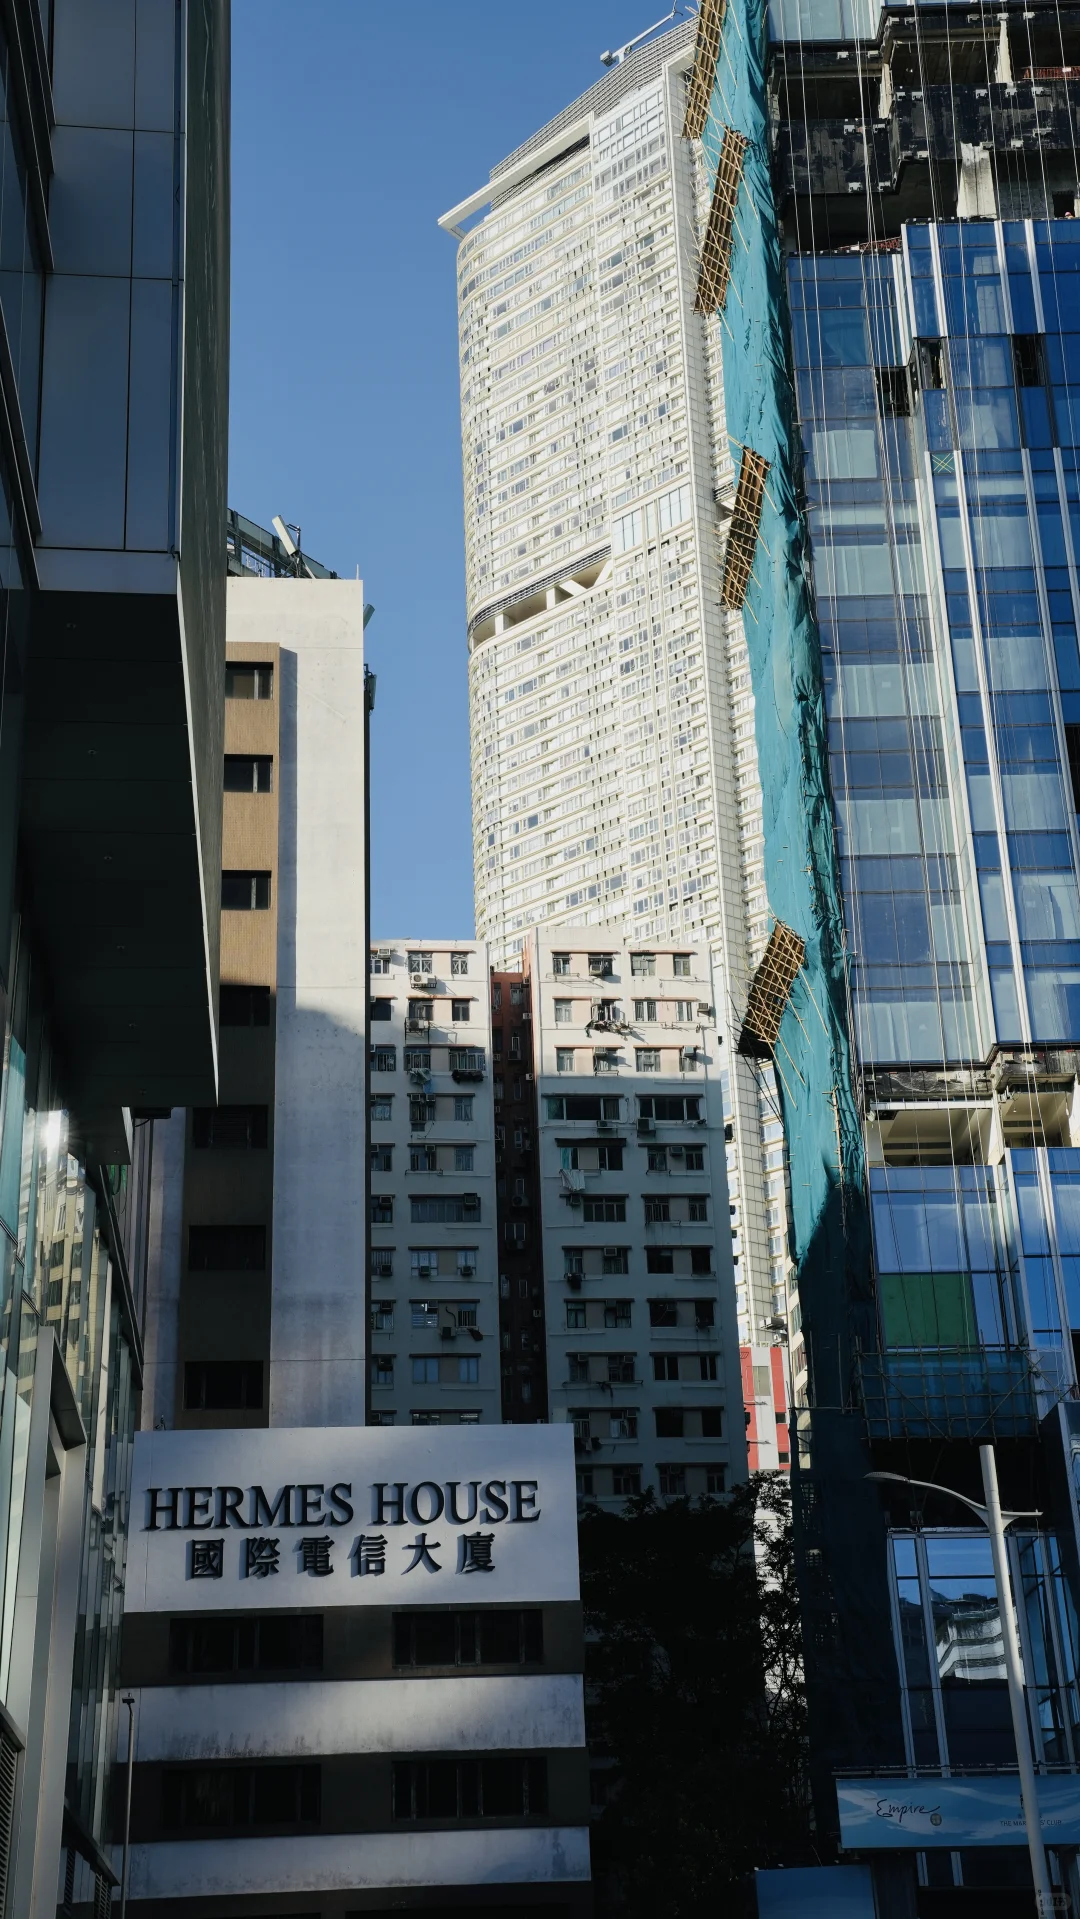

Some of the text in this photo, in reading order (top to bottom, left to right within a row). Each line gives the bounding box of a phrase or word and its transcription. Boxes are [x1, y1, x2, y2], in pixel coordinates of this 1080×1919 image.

[145, 1480, 541, 1530] HERMES HOUSE
[190, 1531, 496, 1579] 國際電信大廈
[876, 1798, 941, 1823] Empire
